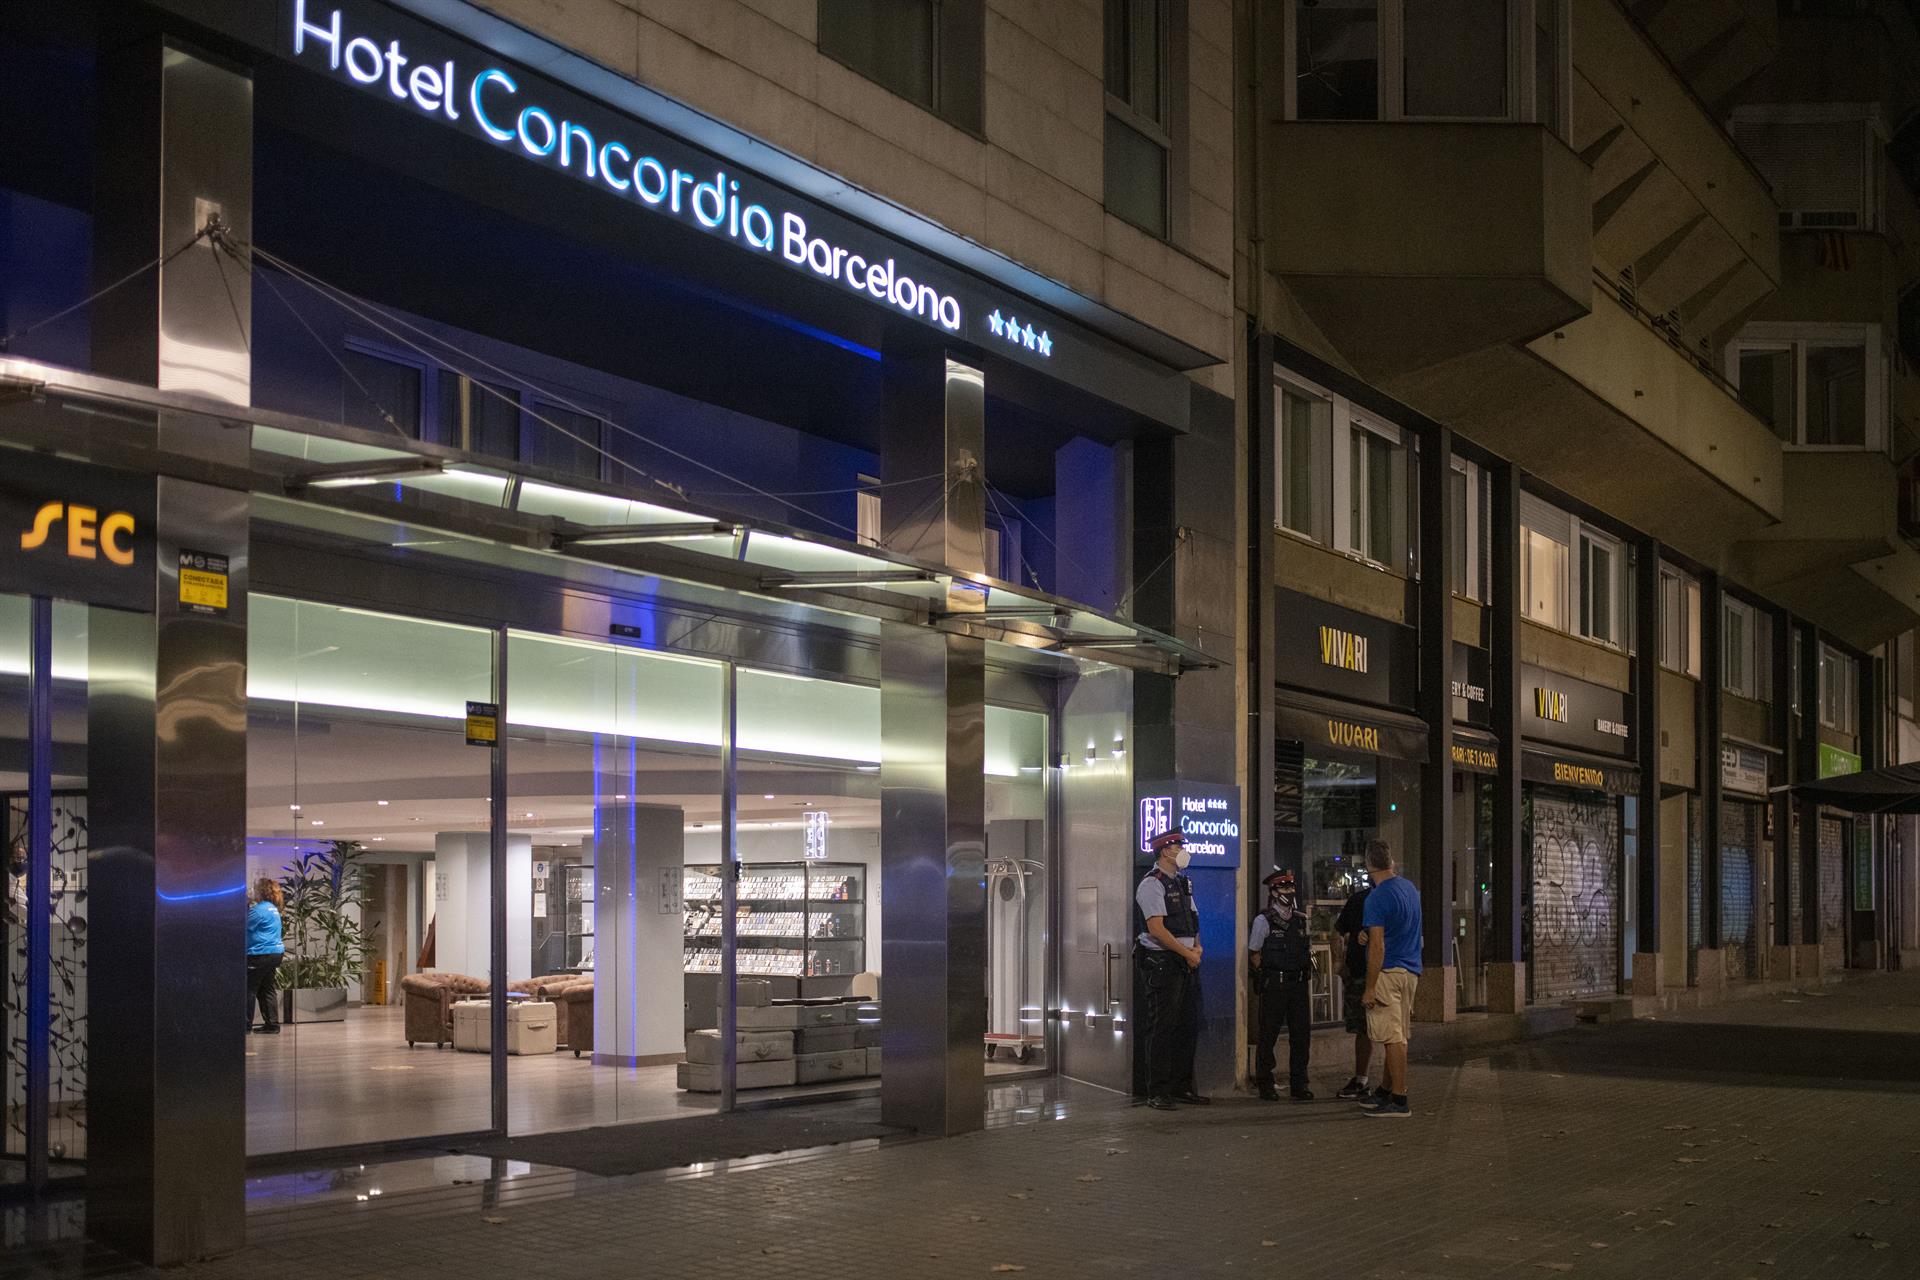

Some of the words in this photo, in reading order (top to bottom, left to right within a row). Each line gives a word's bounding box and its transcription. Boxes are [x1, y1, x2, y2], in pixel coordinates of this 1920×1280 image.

[294, 0, 459, 120] Hotel
[470, 68, 774, 252] Concordia
[783, 211, 961, 330] Barcelona
[20, 500, 136, 566] SEC
[1320, 625, 1368, 673] VIVARI
[1467, 684, 1485, 702] COFFEE
[1538, 687, 1568, 723] VIVARI
[1328, 719, 1379, 752] VIVARI
[1554, 762, 1604, 787] BIENVENIDO
[1182, 797, 1206, 812] Hotel
[1181, 815, 1239, 837] Concordia
